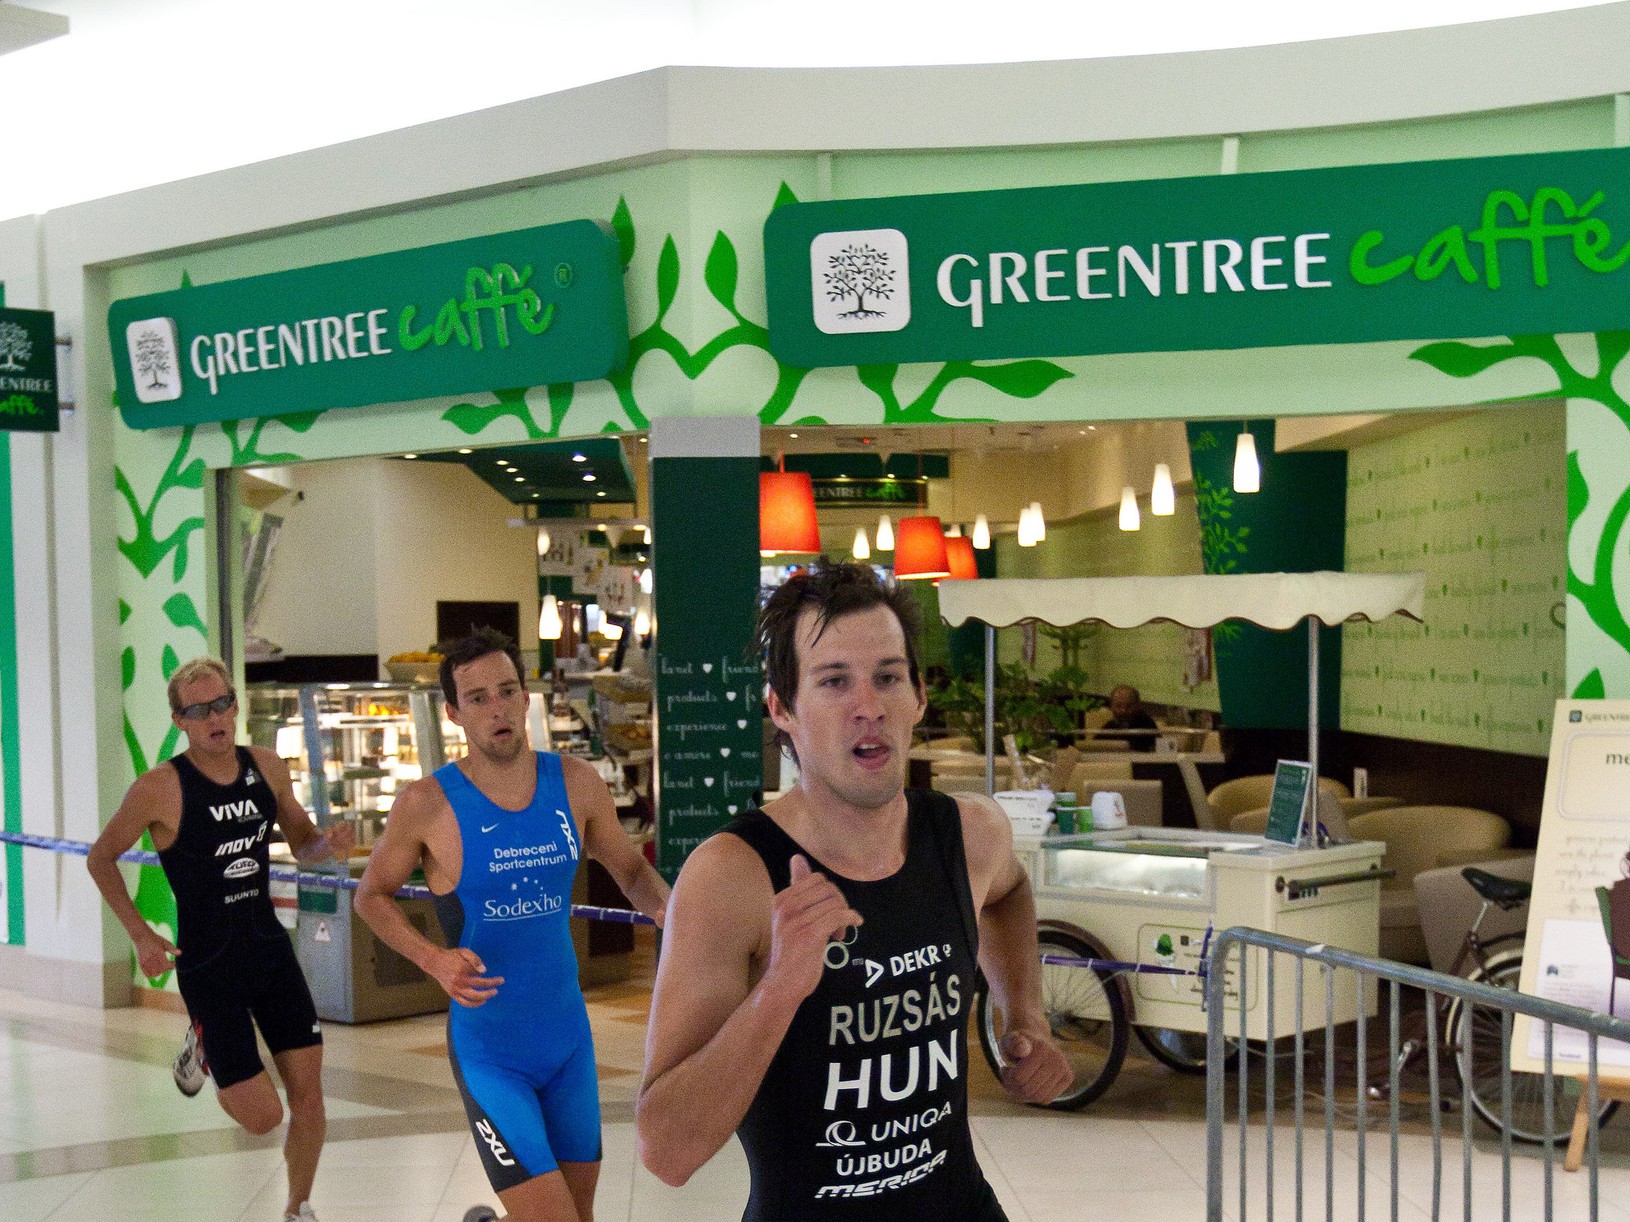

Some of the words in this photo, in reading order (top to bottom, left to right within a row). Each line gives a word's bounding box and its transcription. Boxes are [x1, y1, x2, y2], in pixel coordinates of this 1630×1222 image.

[936, 233, 1333, 328] GREENTREE
[190, 308, 393, 395] GREENTREE
[0, 377, 53, 393] ENTREE
[209, 799, 259, 822] VIVA
[489, 853, 568, 874] Sportcentrum
[493, 840, 558, 859] Debreceni
[224, 888, 259, 904] SUUNTO
[482, 893, 562, 918] Sodexho
[829, 971, 961, 1046] RUZSÁS
[823, 1028, 959, 1112] HUN
[871, 1101, 952, 1142] UNIQA
[836, 1138, 933, 1177] ÚJBUDA
